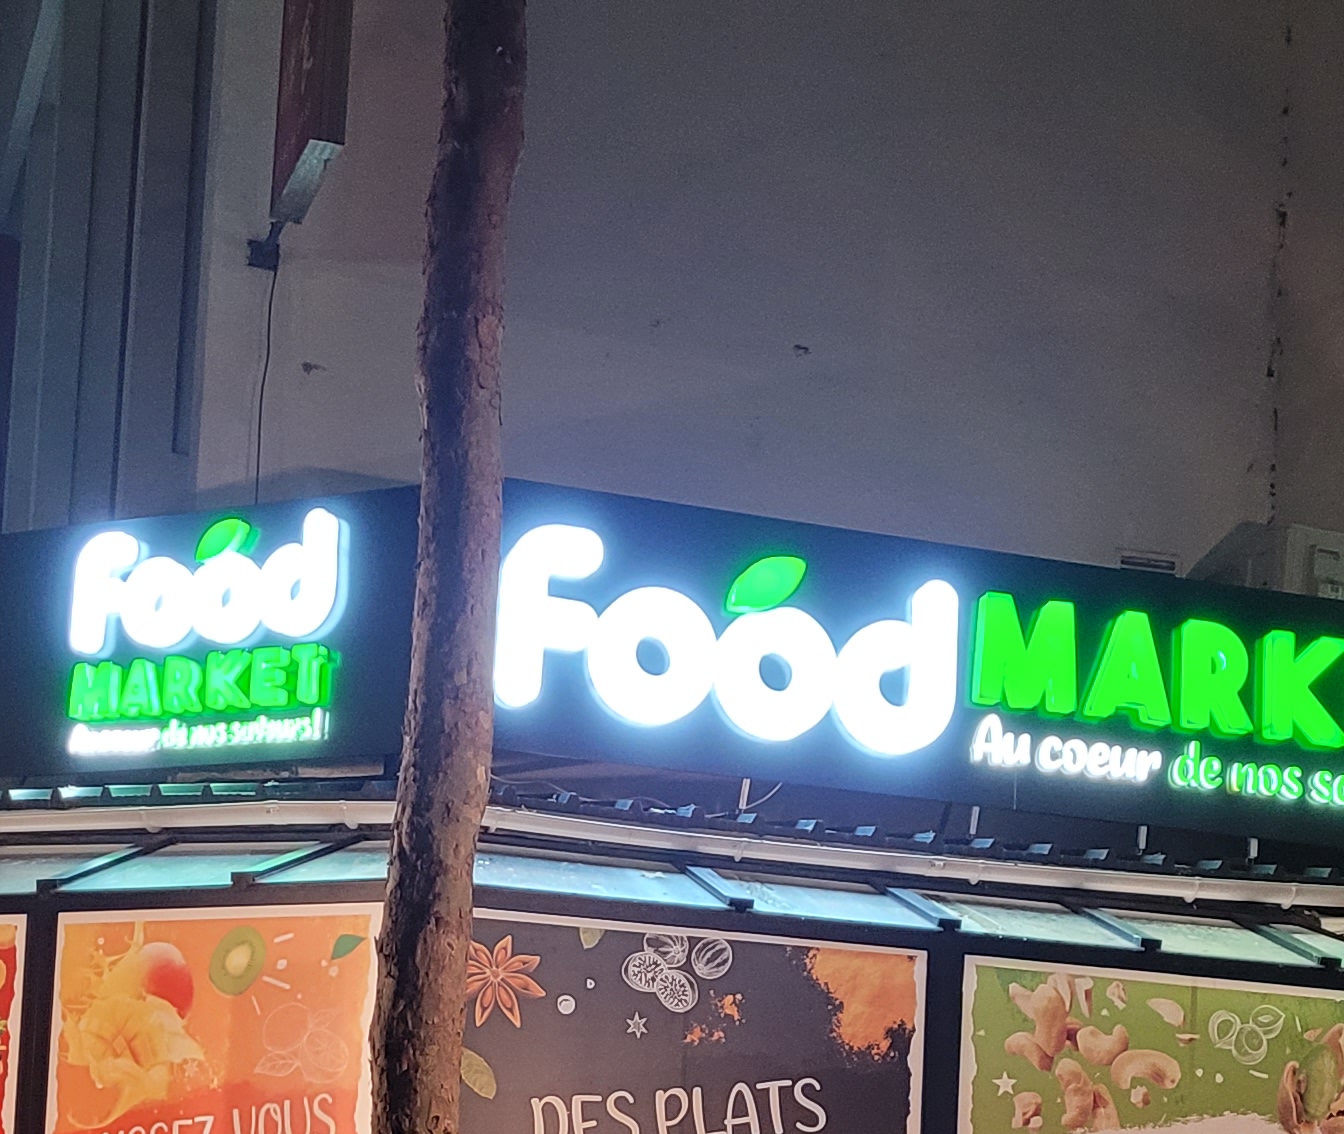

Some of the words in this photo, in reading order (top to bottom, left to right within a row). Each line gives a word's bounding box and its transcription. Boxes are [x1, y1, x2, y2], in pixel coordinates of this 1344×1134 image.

[68, 643, 338, 721] MARKET
[971, 713, 1030, 764] Au
[1036, 735, 1162, 784] coeur
[1168, 741, 1223, 791] de
[1226, 761, 1304, 800] nos
